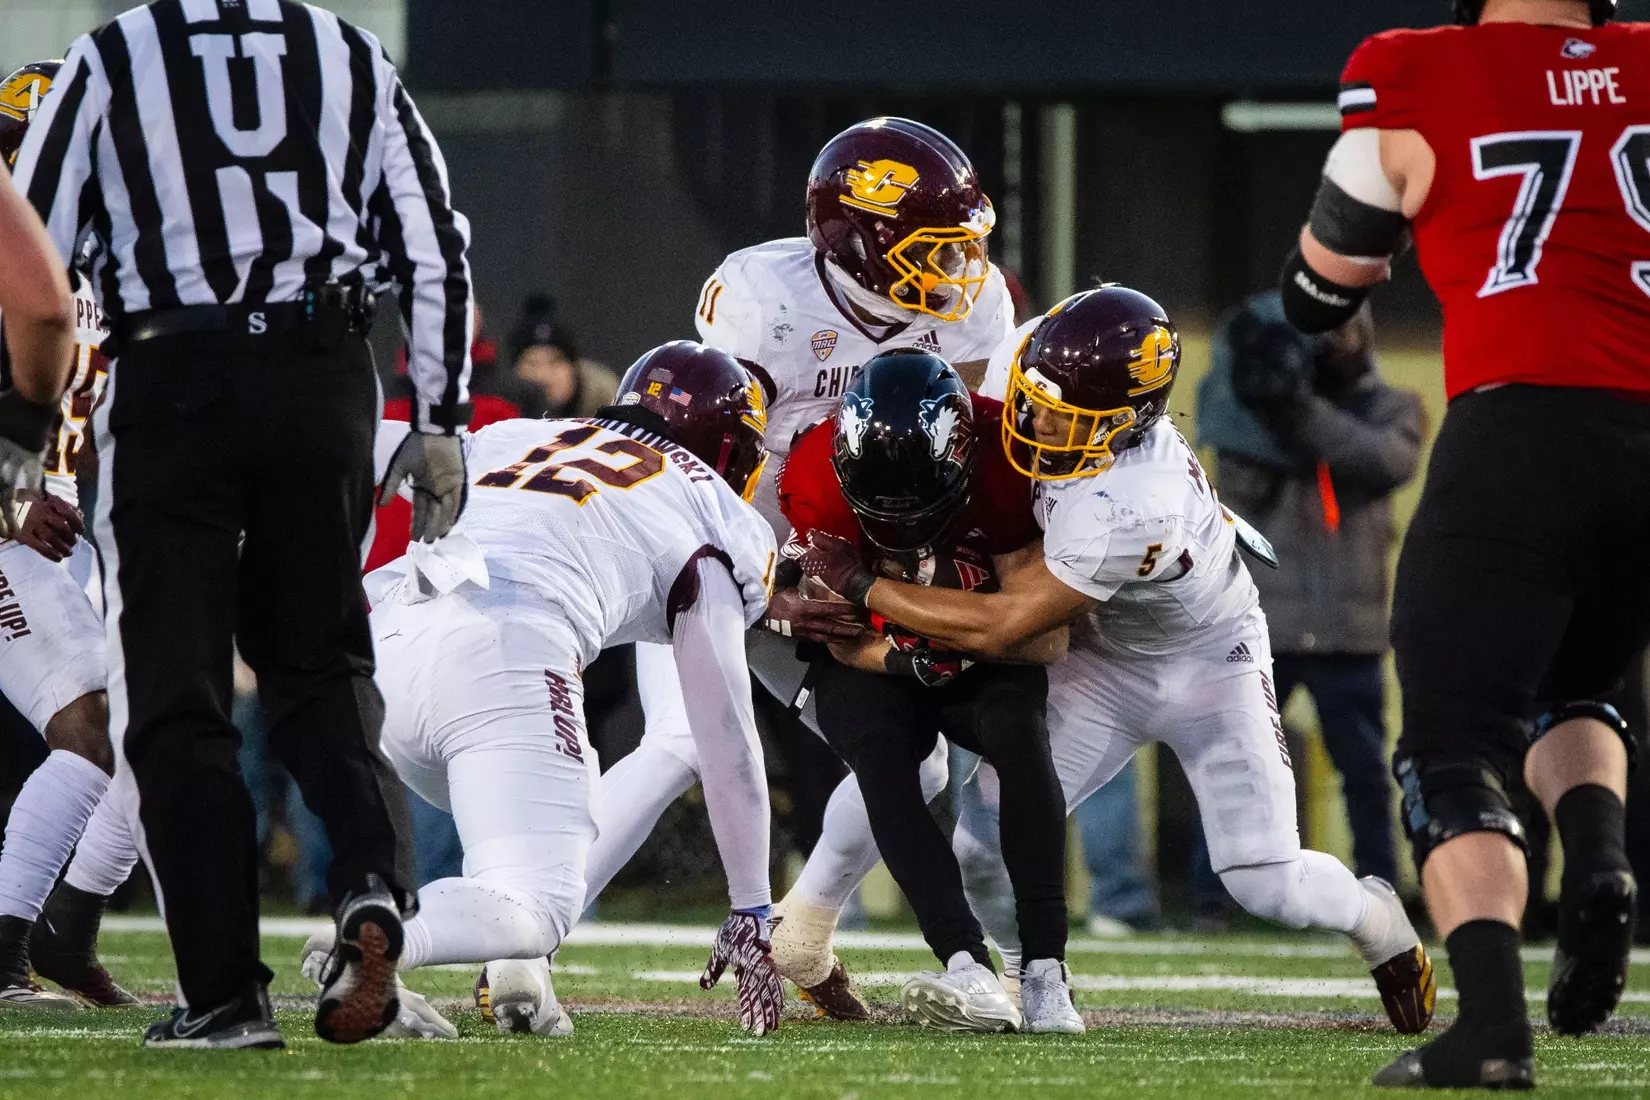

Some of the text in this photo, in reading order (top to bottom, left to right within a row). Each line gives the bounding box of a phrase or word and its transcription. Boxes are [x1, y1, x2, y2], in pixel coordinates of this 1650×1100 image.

[189, 33, 287, 157] U
[1546, 67, 1626, 105] LIPPE
[699, 279, 724, 326] 11
[248, 312, 268, 334] S
[812, 338, 836, 349] MAC
[911, 341, 942, 353] adidas
[647, 381, 662, 397] 12
[474, 425, 666, 507] 12
[1136, 543, 1163, 577] 5
[1226, 655, 1254, 663] adidas
[553, 714, 584, 765] UP!
